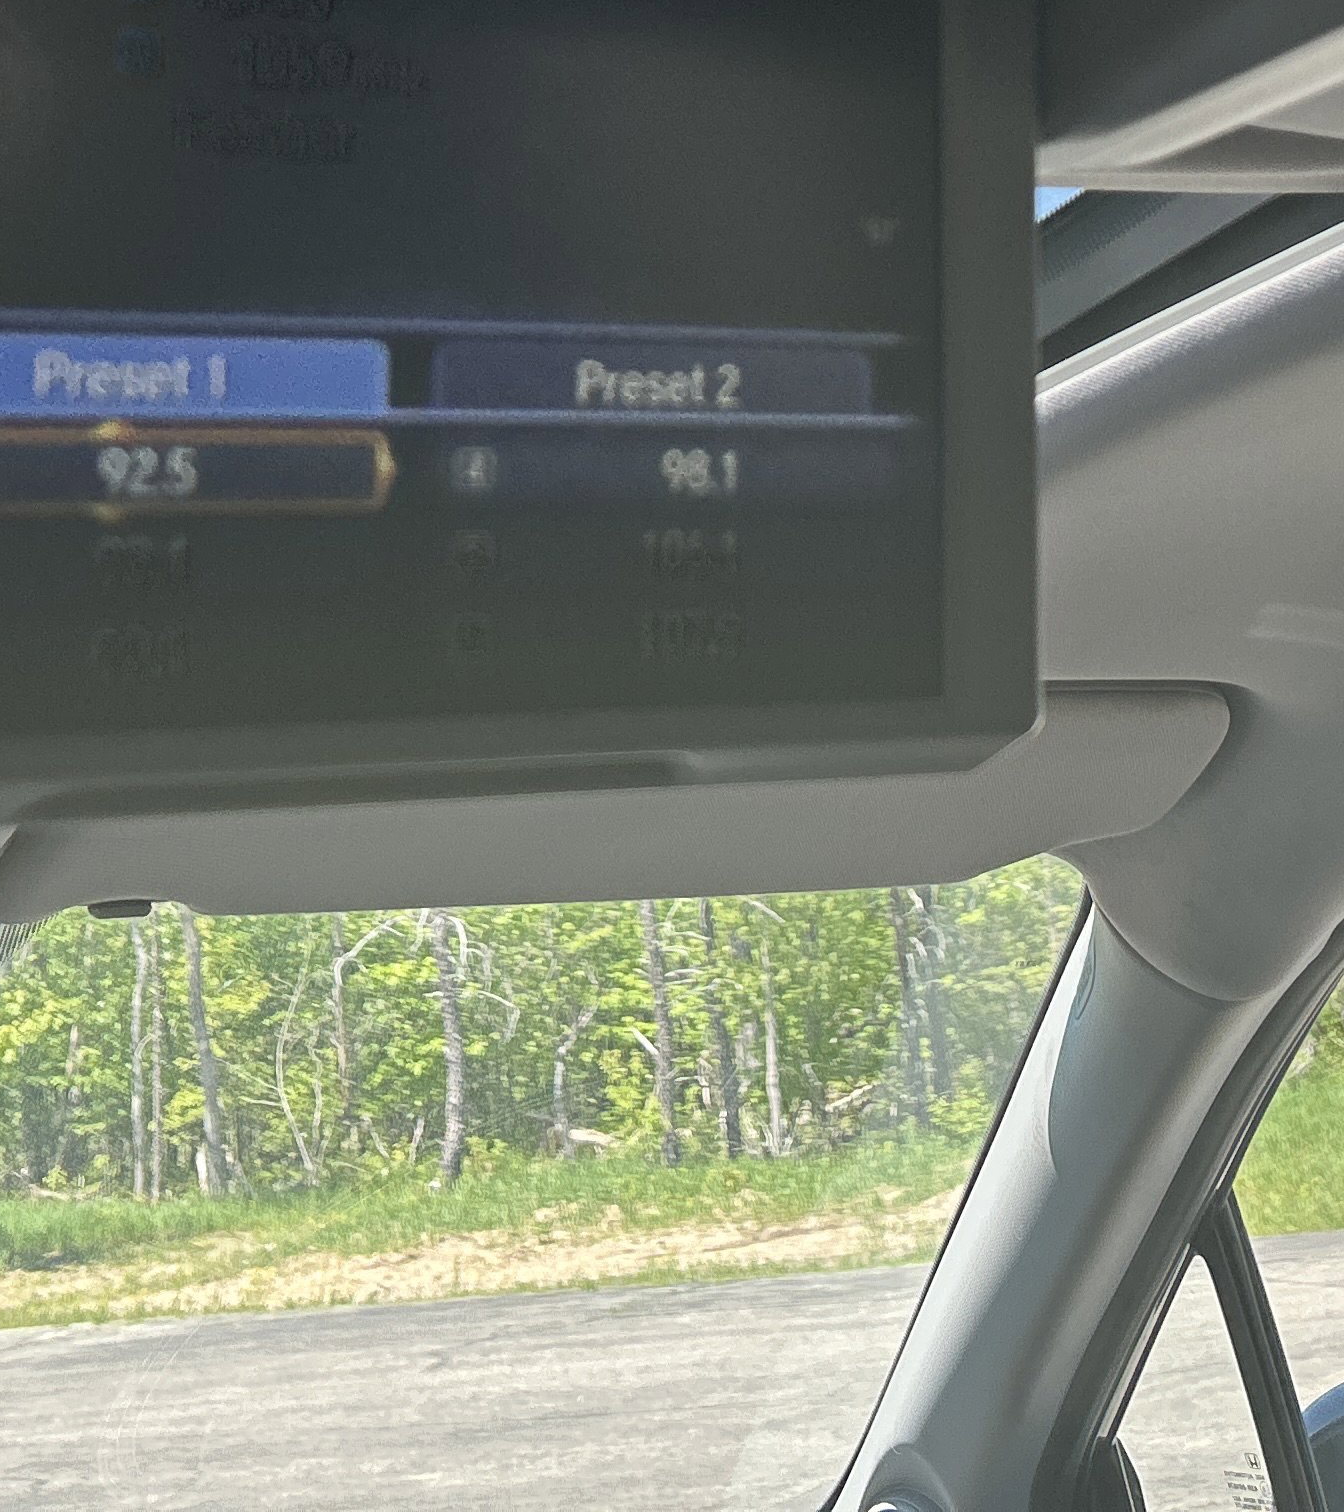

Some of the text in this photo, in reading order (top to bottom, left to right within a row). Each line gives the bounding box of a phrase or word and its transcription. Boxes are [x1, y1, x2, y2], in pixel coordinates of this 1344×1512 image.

[31, 348, 228, 401] Preset 1
[575, 358, 742, 409] Preset 2
